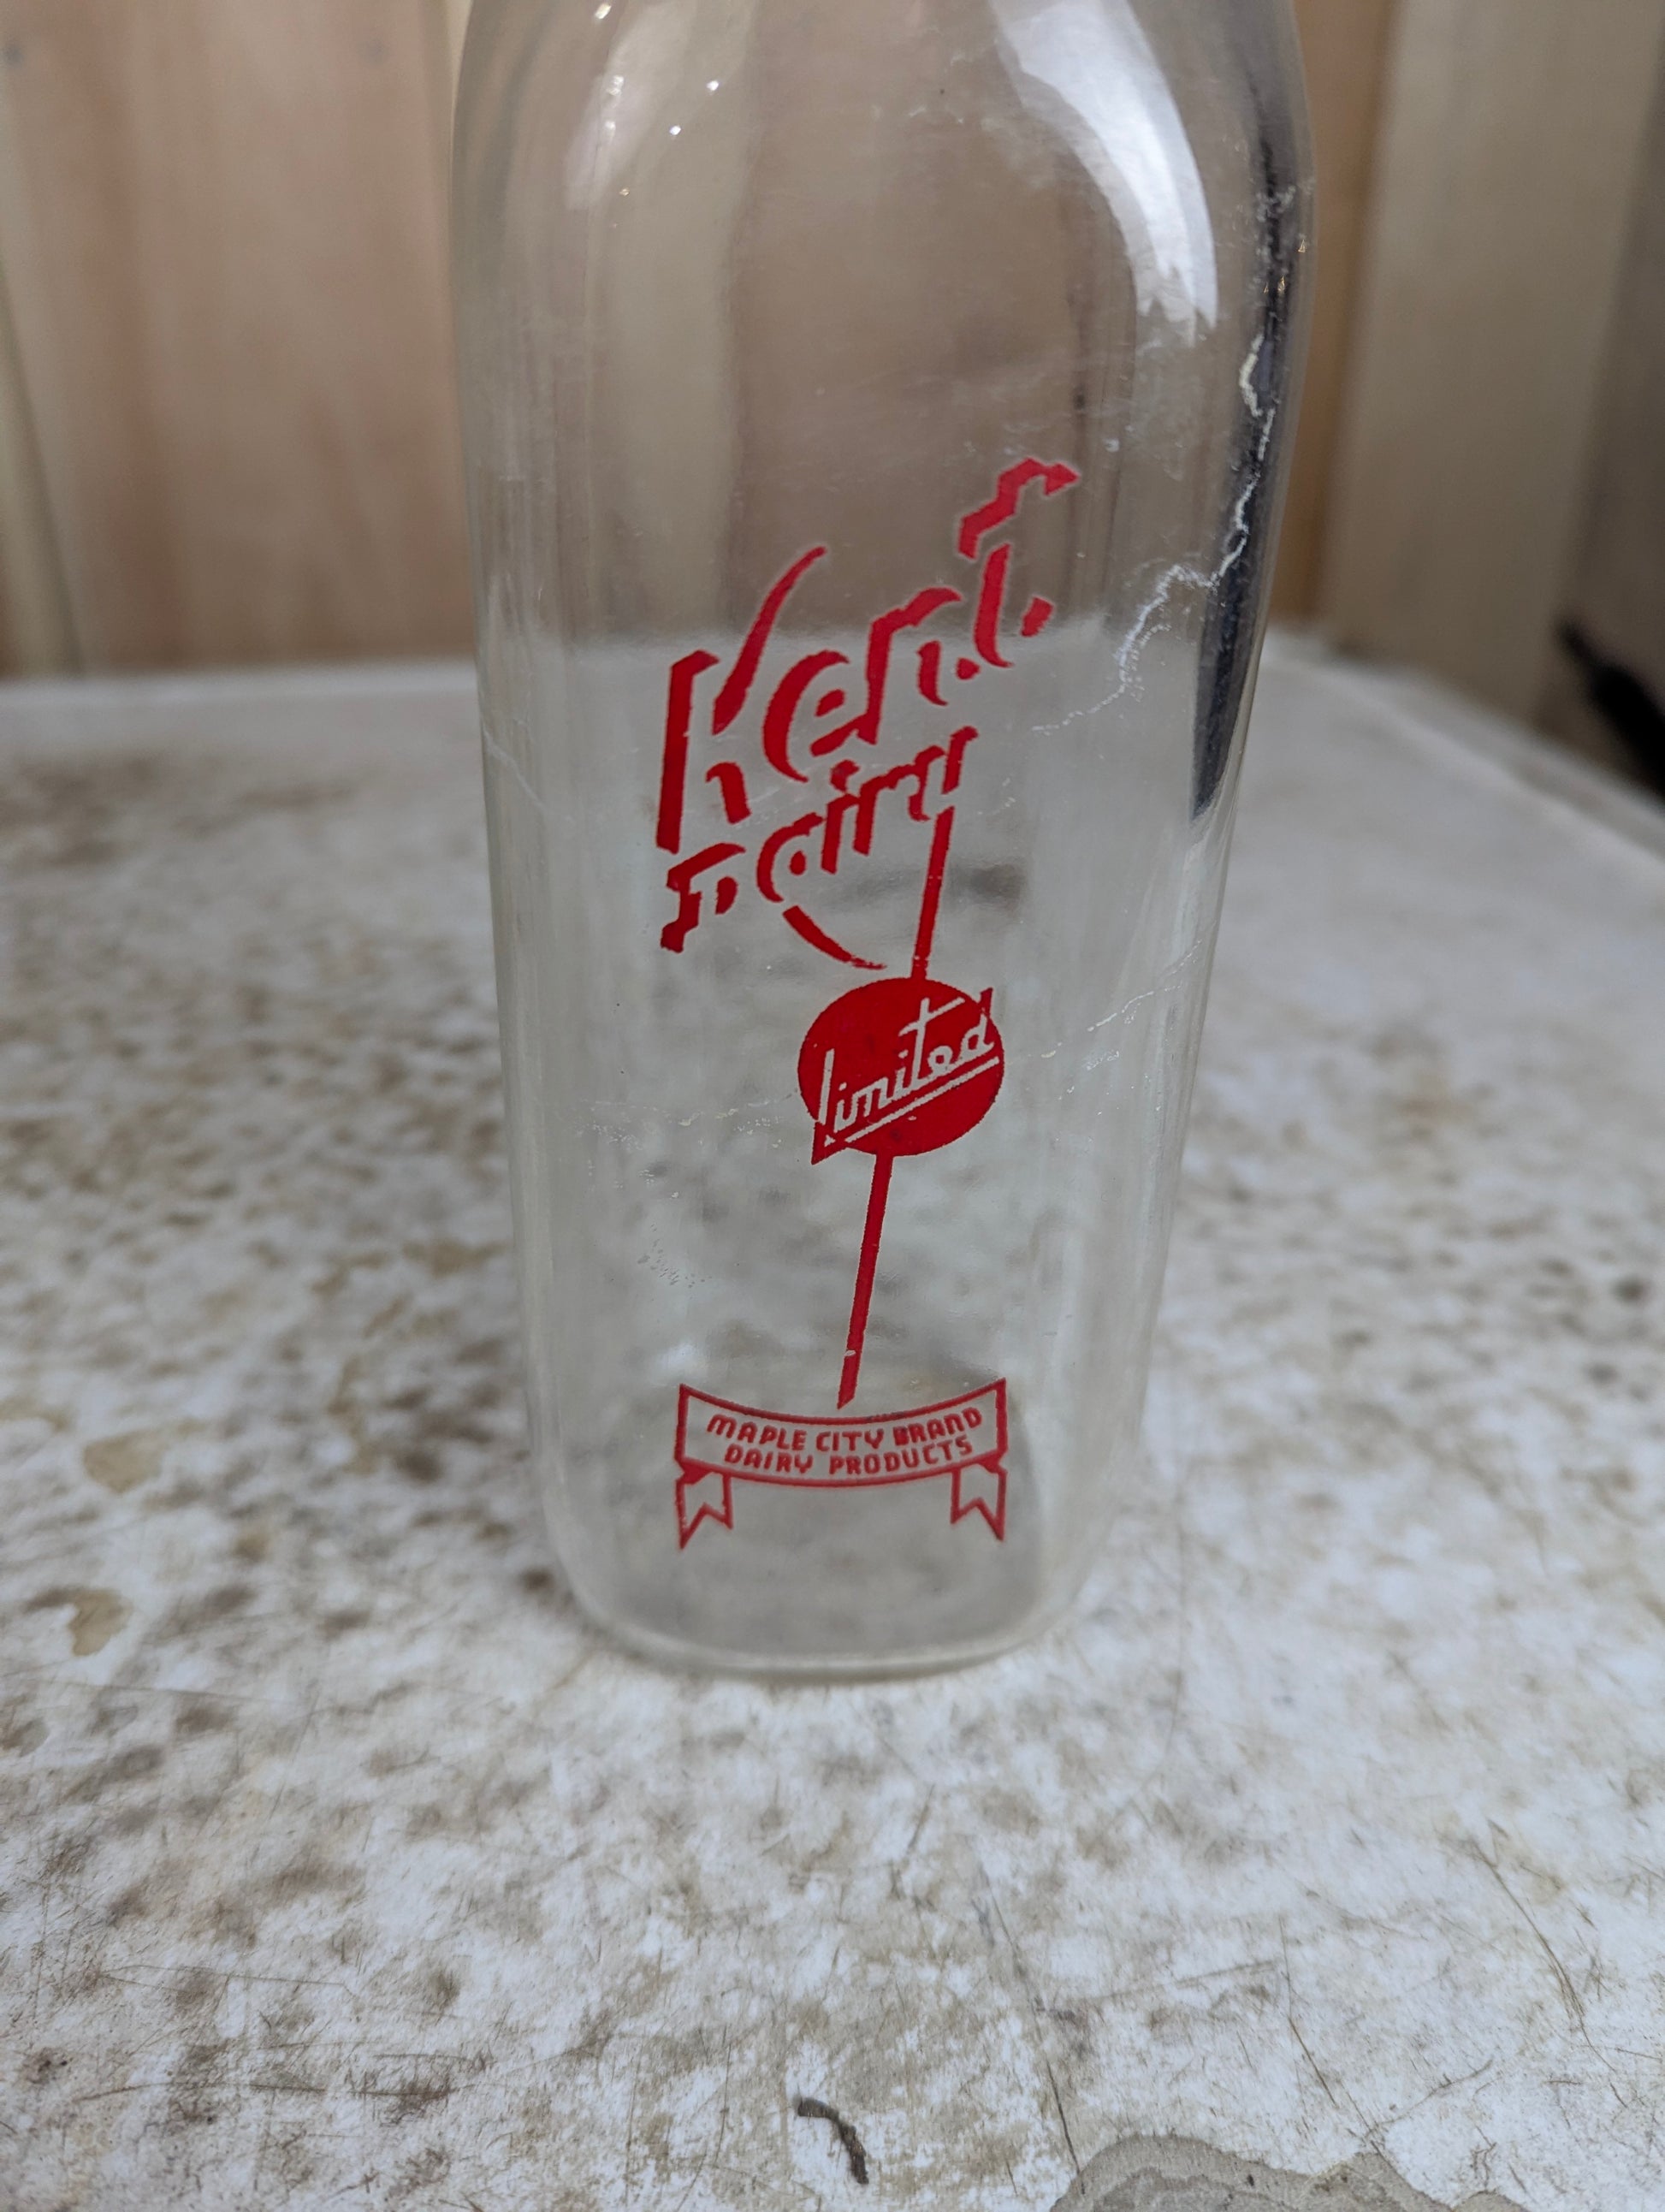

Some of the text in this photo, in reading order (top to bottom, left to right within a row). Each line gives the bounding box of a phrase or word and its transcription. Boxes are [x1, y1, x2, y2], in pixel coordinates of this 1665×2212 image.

[655, 457, 1079, 855] Kent
[707, 1408, 982, 1452] MAPLE CITY BRAND
[724, 1434, 973, 1475] DAIRY PRODUCTS
